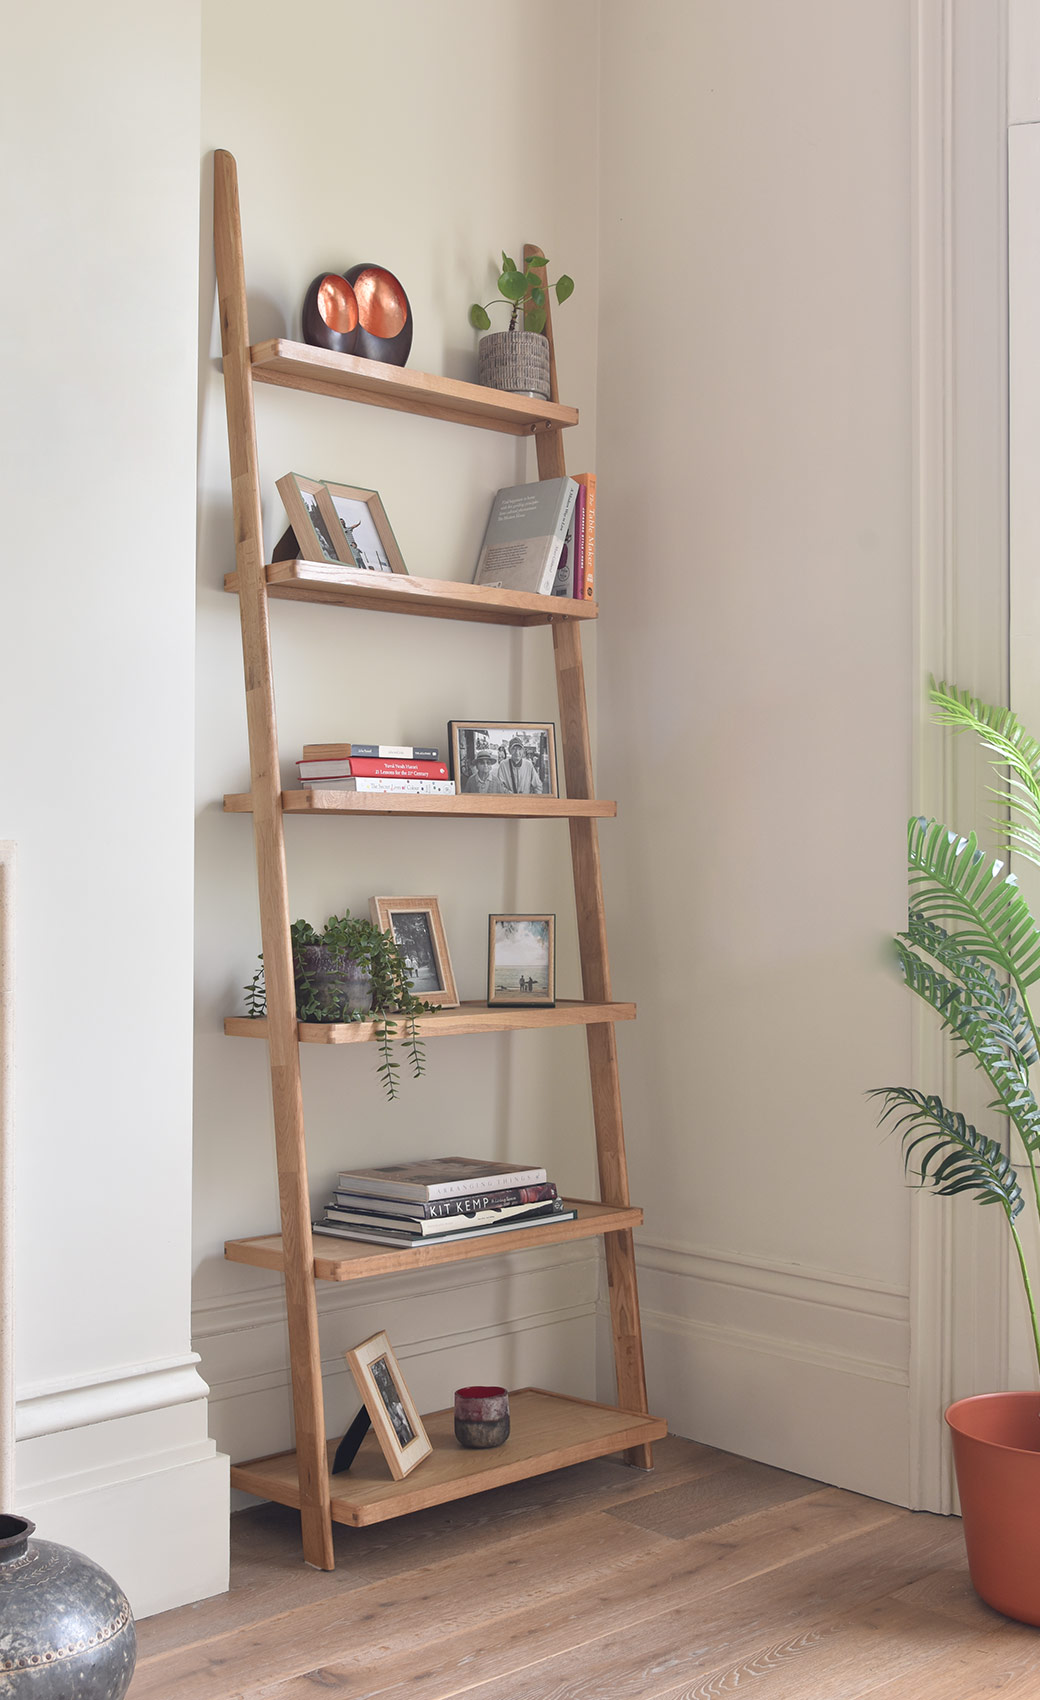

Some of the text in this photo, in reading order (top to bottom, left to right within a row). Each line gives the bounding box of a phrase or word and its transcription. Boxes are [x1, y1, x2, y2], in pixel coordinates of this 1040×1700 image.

[588, 509, 596, 532] Table
[587, 537, 595, 567] Maker
[437, 1175, 532, 1194] ARRANGING THINGS
[429, 1203, 451, 1218] KIT
[456, 1197, 490, 1213] KEMP
